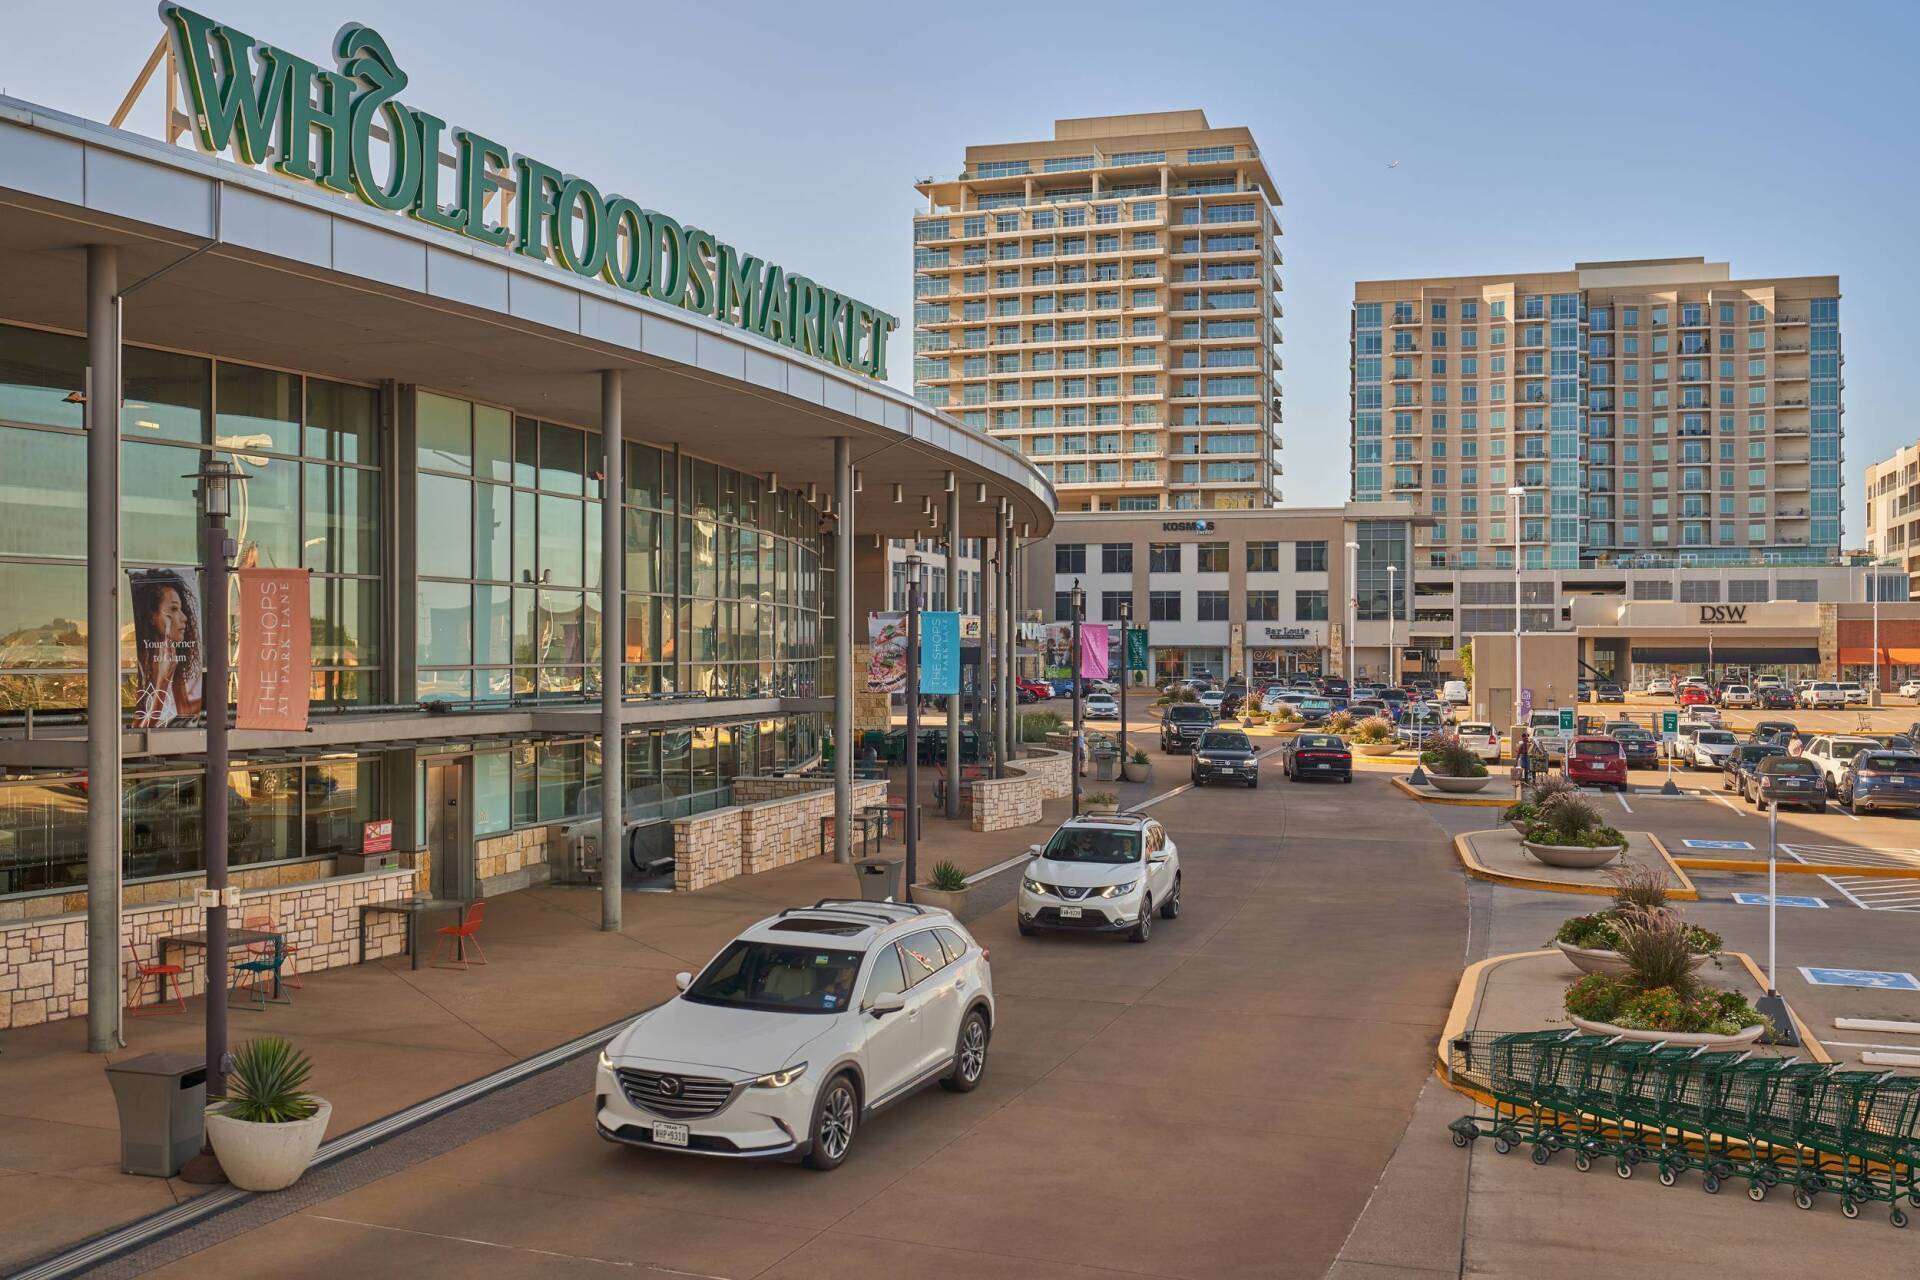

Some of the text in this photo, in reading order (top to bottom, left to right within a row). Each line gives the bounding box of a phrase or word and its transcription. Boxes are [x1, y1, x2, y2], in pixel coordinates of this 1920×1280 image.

[160, 2, 896, 380] WHOLE FOODS MARKET
[1163, 519, 1215, 531] KOSMOS
[1265, 627, 1310, 635] Bar Louie
[1700, 605, 1747, 621] DSW
[143, 639, 196, 649] Your Corner
[259, 581, 278, 716] THE SHOPS
[277, 582, 292, 716] AT PARK LANE
[932, 618, 942, 686] THE SHOPS
